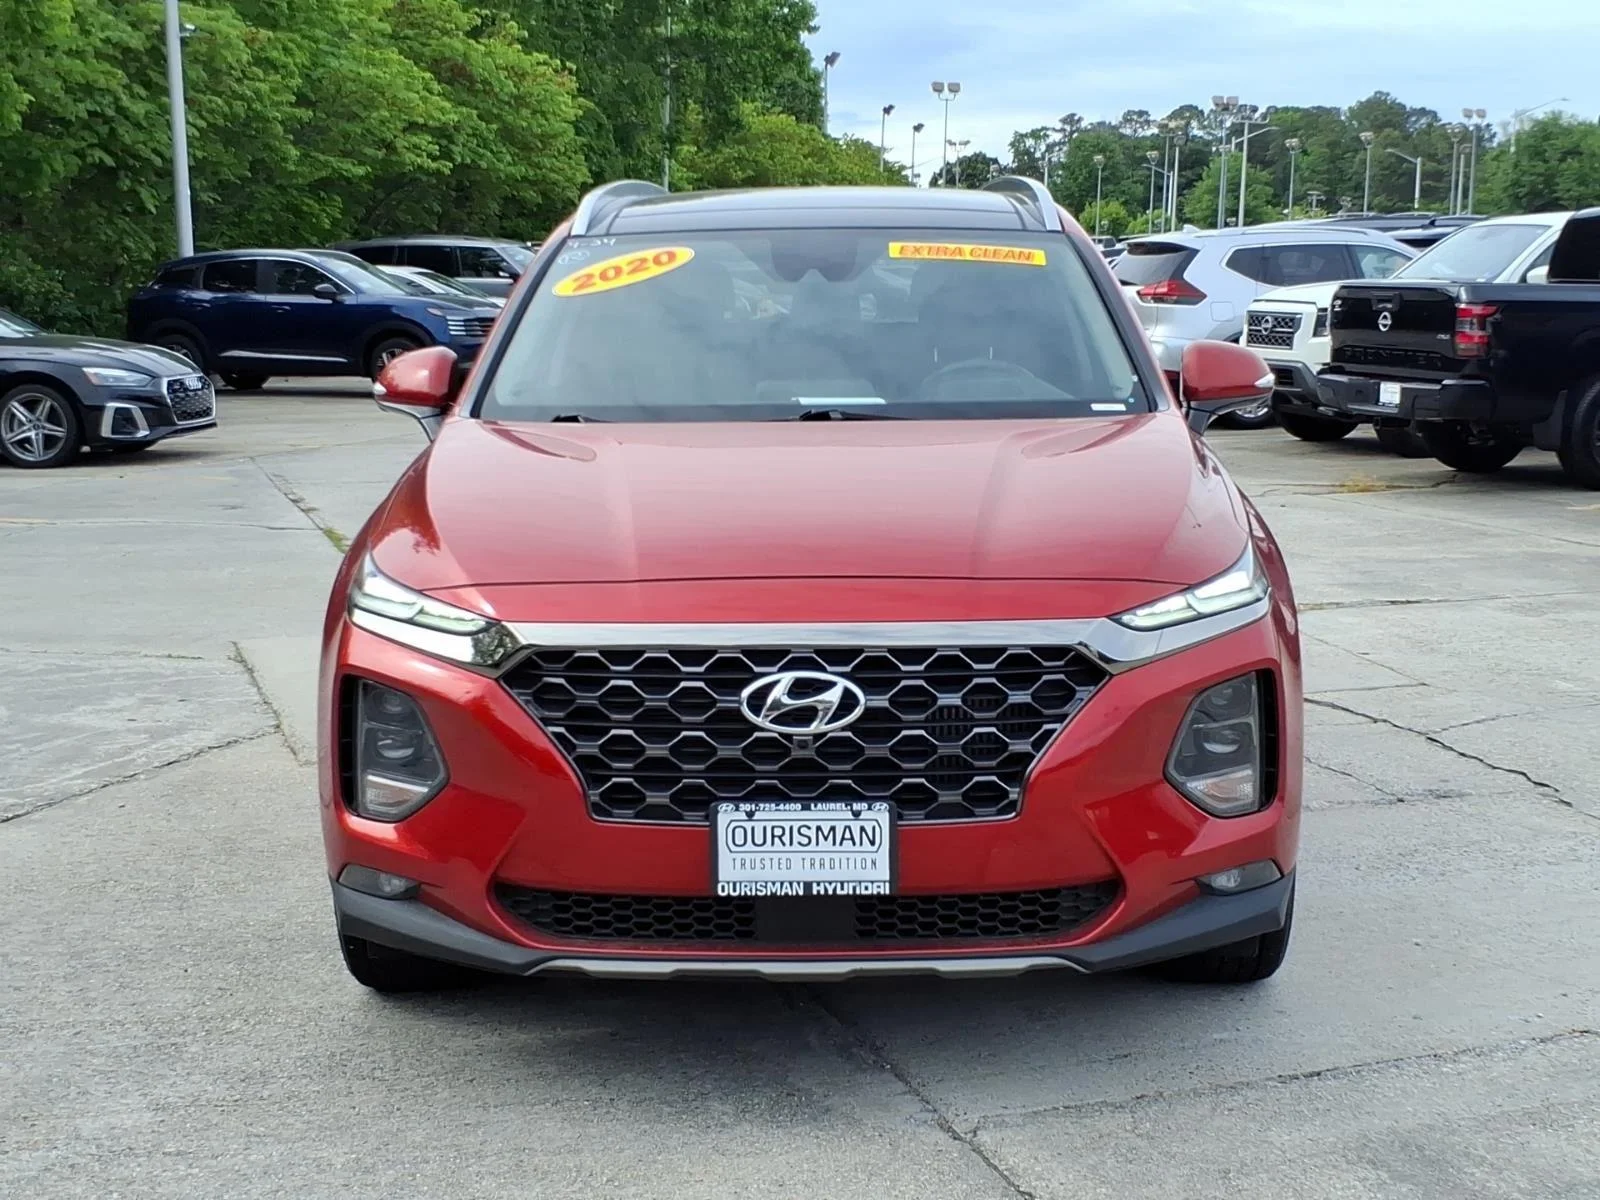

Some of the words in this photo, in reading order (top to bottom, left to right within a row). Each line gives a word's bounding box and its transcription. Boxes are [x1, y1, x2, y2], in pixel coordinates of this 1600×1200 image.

[899, 245, 964, 259] EXTRA
[572, 250, 677, 292] 2020
[731, 824, 876, 848] OURISMAN
[732, 857, 792, 871] TRUSTED
[801, 857, 877, 871] TRADITION
[717, 881, 804, 896] OURISMAN
